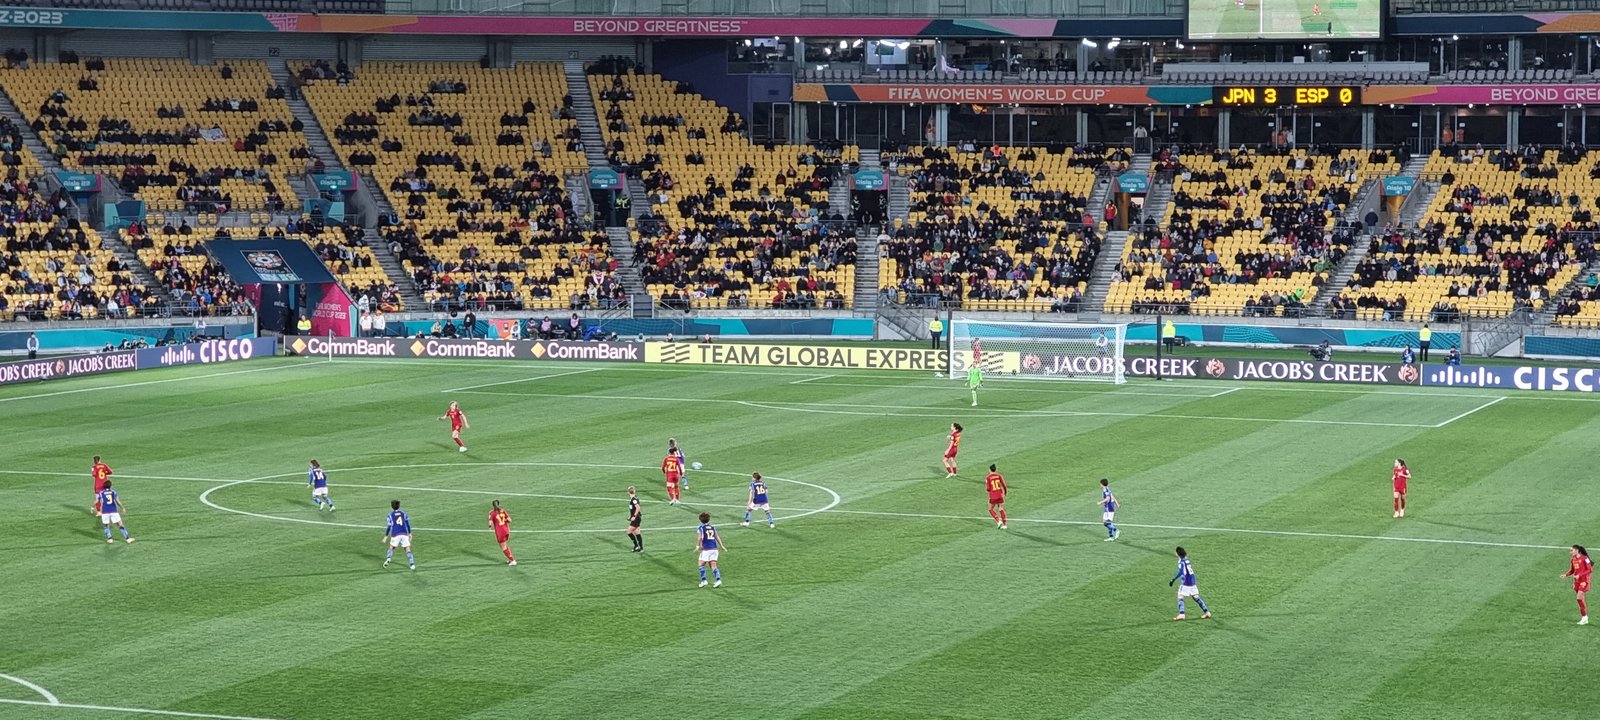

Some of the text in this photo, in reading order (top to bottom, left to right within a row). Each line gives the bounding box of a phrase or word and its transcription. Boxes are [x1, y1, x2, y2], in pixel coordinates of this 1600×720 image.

[574, 21, 640, 33] BEYOND
[888, 88, 1105, 101] FIFA WOMEN'S WORLD CUP
[1222, 88, 1352, 103] JPN 3 ESP 0
[1491, 88, 1600, 101] BEYOND GRE
[199, 338, 253, 364] CISCO
[307, 339, 395, 356] CommBank
[426, 340, 516, 358] CommBank
[547, 342, 638, 360] CommBank
[66, 353, 135, 376] JACOB'S CREEK
[698, 344, 966, 370] TEAM GLOBAL EXPRESS
[21, 361, 54, 380] CREEK
[1131, 358, 1197, 376] CREEK
[1233, 360, 1388, 383] JACOB'S CREEK
[1513, 366, 1600, 392] CISC
[98, 469, 105, 479] 6
[666, 461, 677, 472] 21
[315, 471, 325, 480] 14
[756, 485, 765, 495] 16
[106, 495, 113, 505] 3
[396, 516, 403, 526] 4
[705, 529, 715, 540] 12
